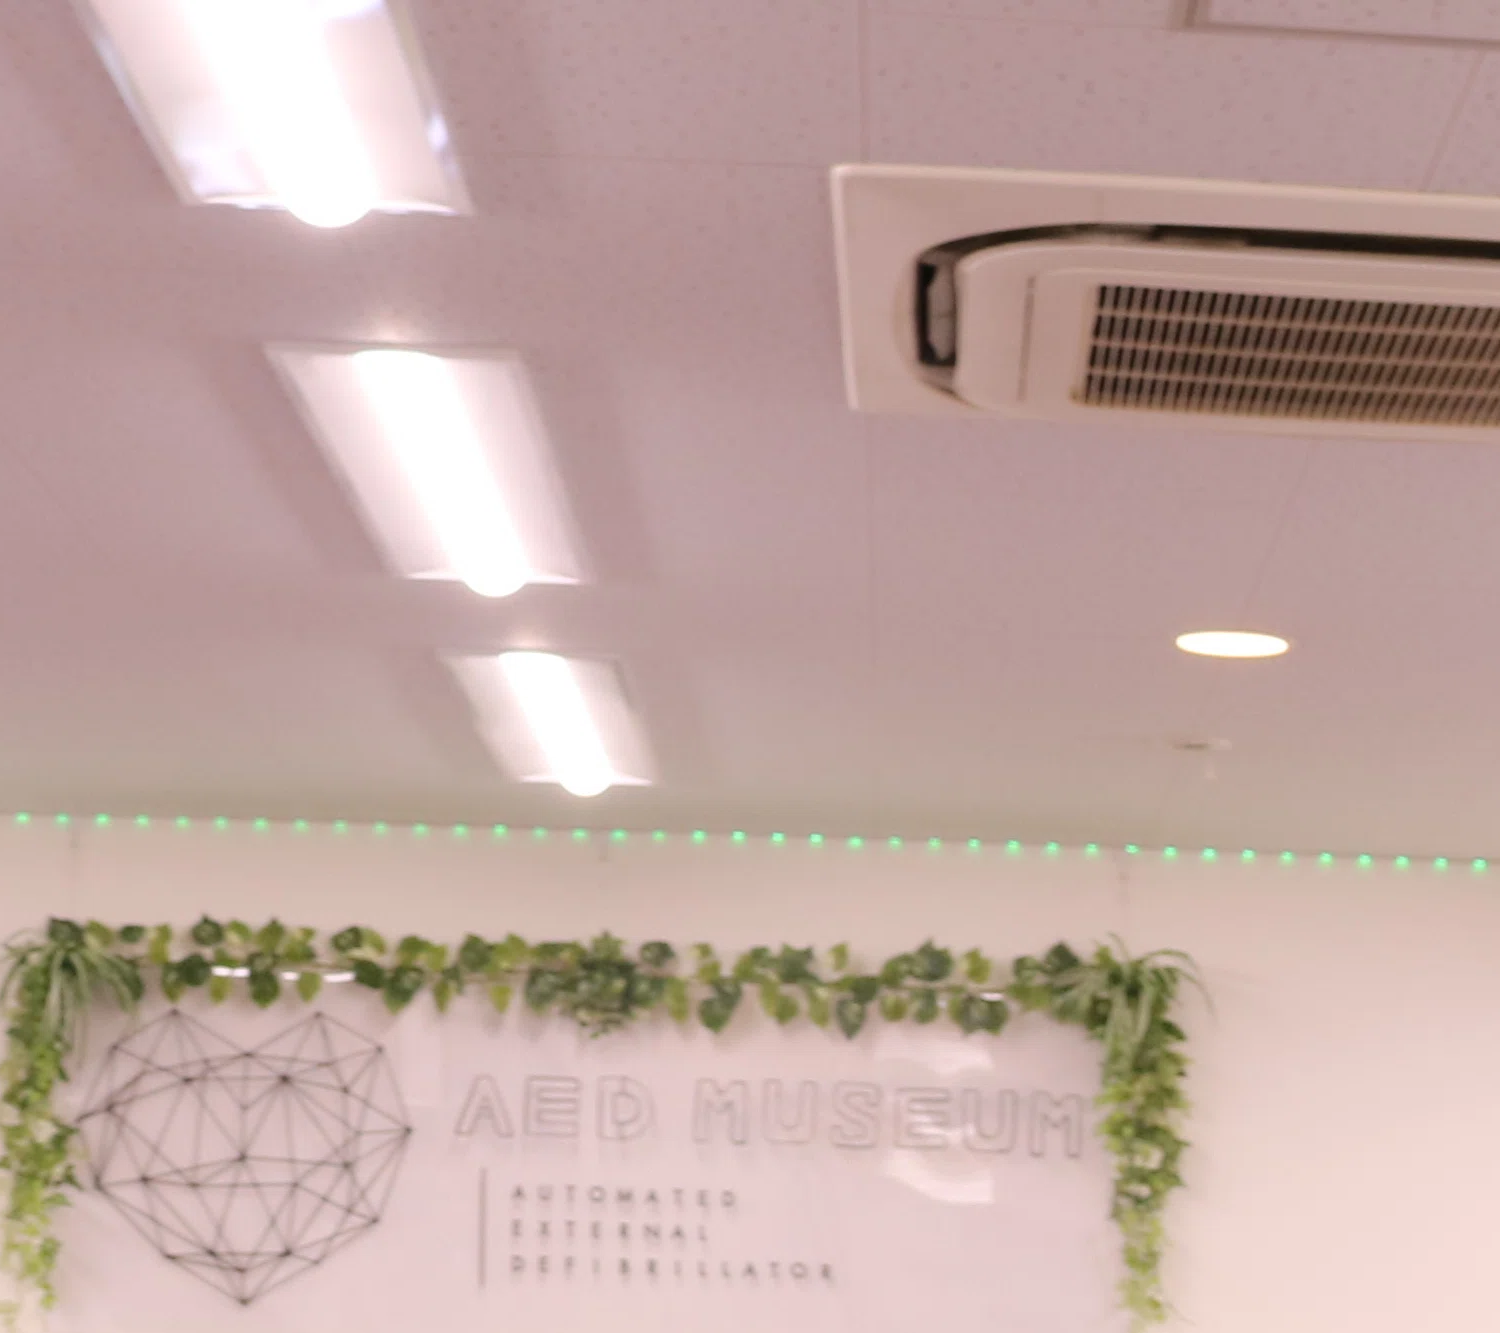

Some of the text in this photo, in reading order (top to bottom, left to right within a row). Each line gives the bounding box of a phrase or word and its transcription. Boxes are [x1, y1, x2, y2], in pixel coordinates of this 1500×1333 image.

[453, 1072, 1086, 1160] AED MUSEUM
[510, 1183, 737, 1208] AUTOMATED
[510, 1218, 709, 1242] EXTERNAL
[510, 1254, 833, 1283] DEFIBRILLATOR
